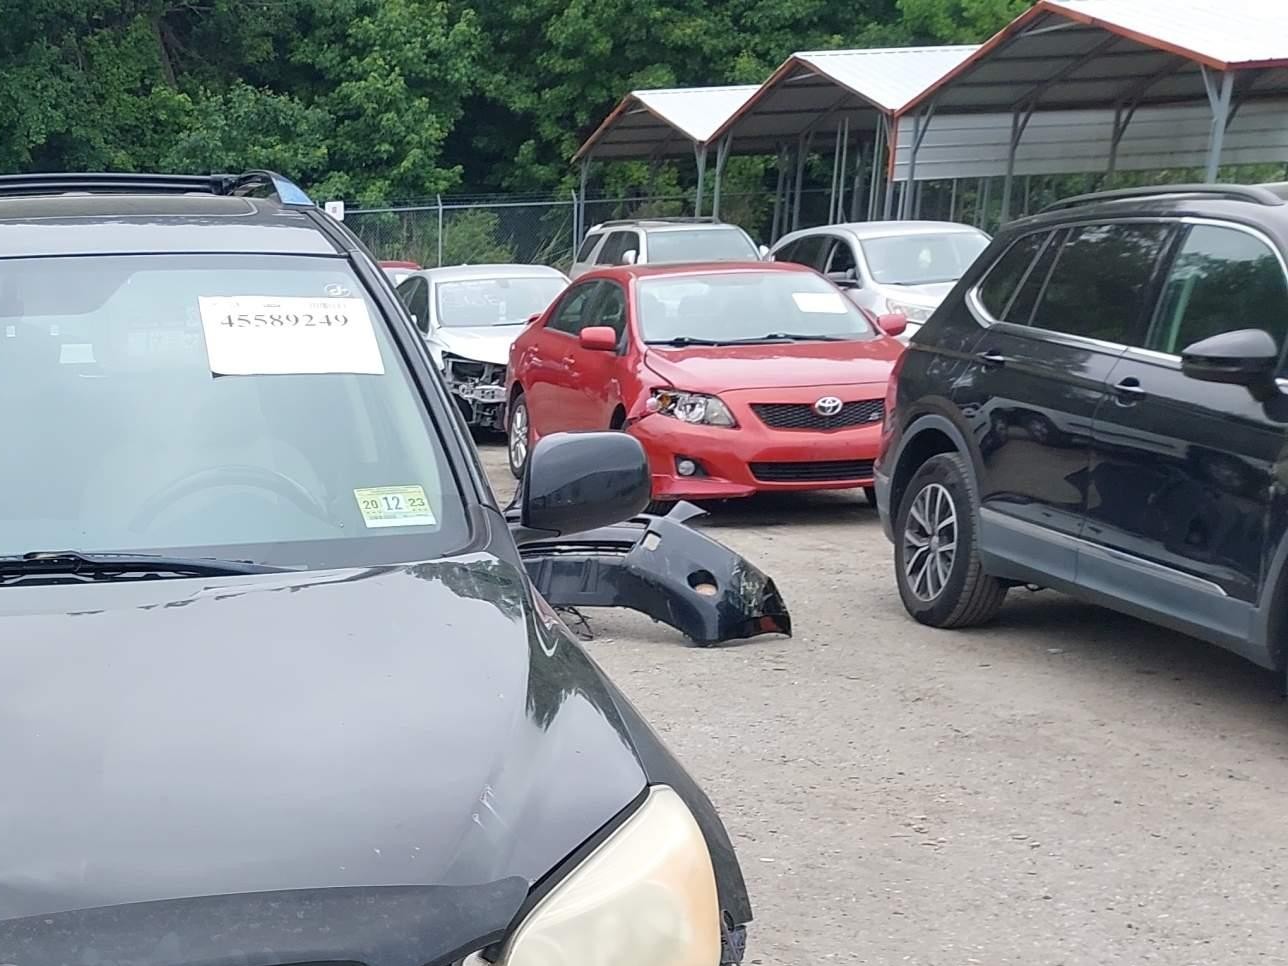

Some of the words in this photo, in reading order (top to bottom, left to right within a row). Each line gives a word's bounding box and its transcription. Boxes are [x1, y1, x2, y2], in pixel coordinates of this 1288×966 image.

[220, 313, 350, 328] 45589249
[362, 499, 379, 510] 20
[382, 495, 403, 511] 12
[407, 497, 425, 507] 23
